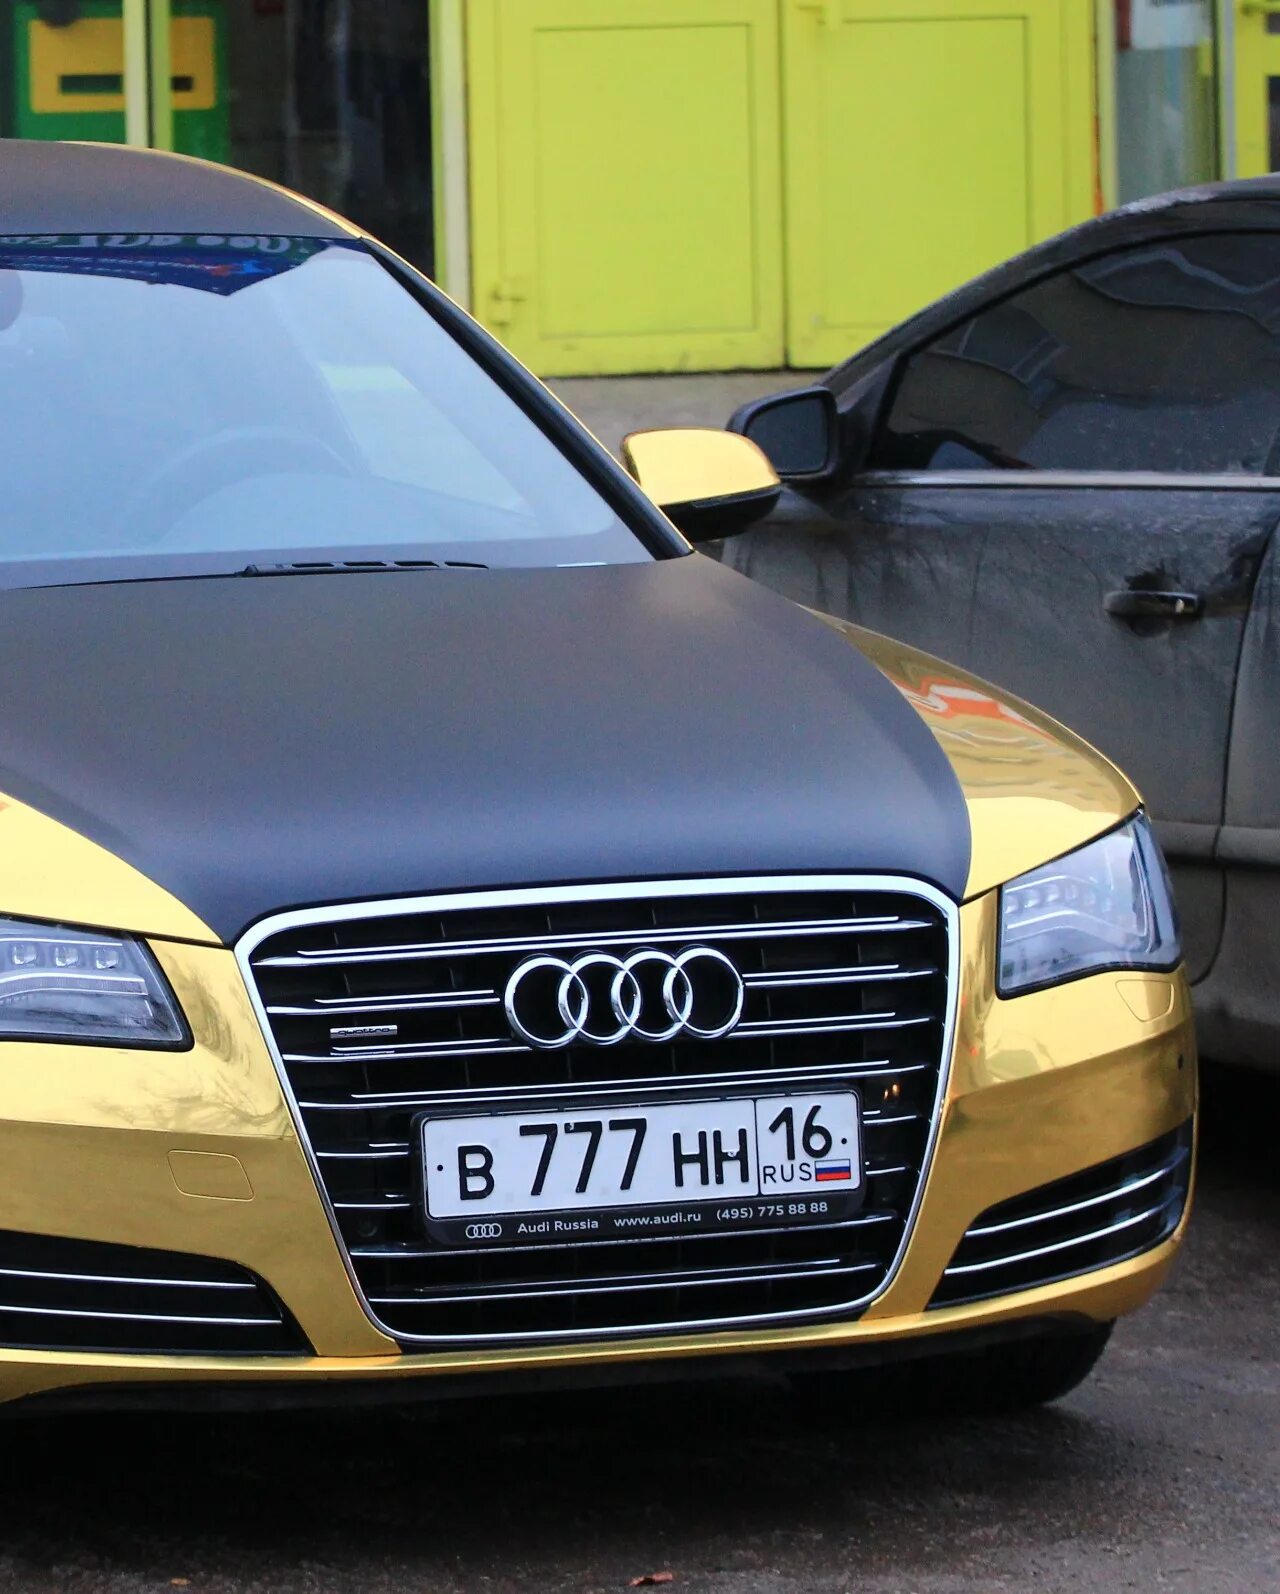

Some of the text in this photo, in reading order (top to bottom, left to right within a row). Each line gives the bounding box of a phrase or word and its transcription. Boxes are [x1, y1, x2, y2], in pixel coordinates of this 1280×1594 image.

[337, 1027, 390, 1036] quattro
[519, 1117, 647, 1196] 777
[768, 1104, 833, 1161] 16
[762, 1162, 812, 1185] RUS
[517, 1201, 828, 1234] Audi Russia www.audi.ru (495) 775 88 88
